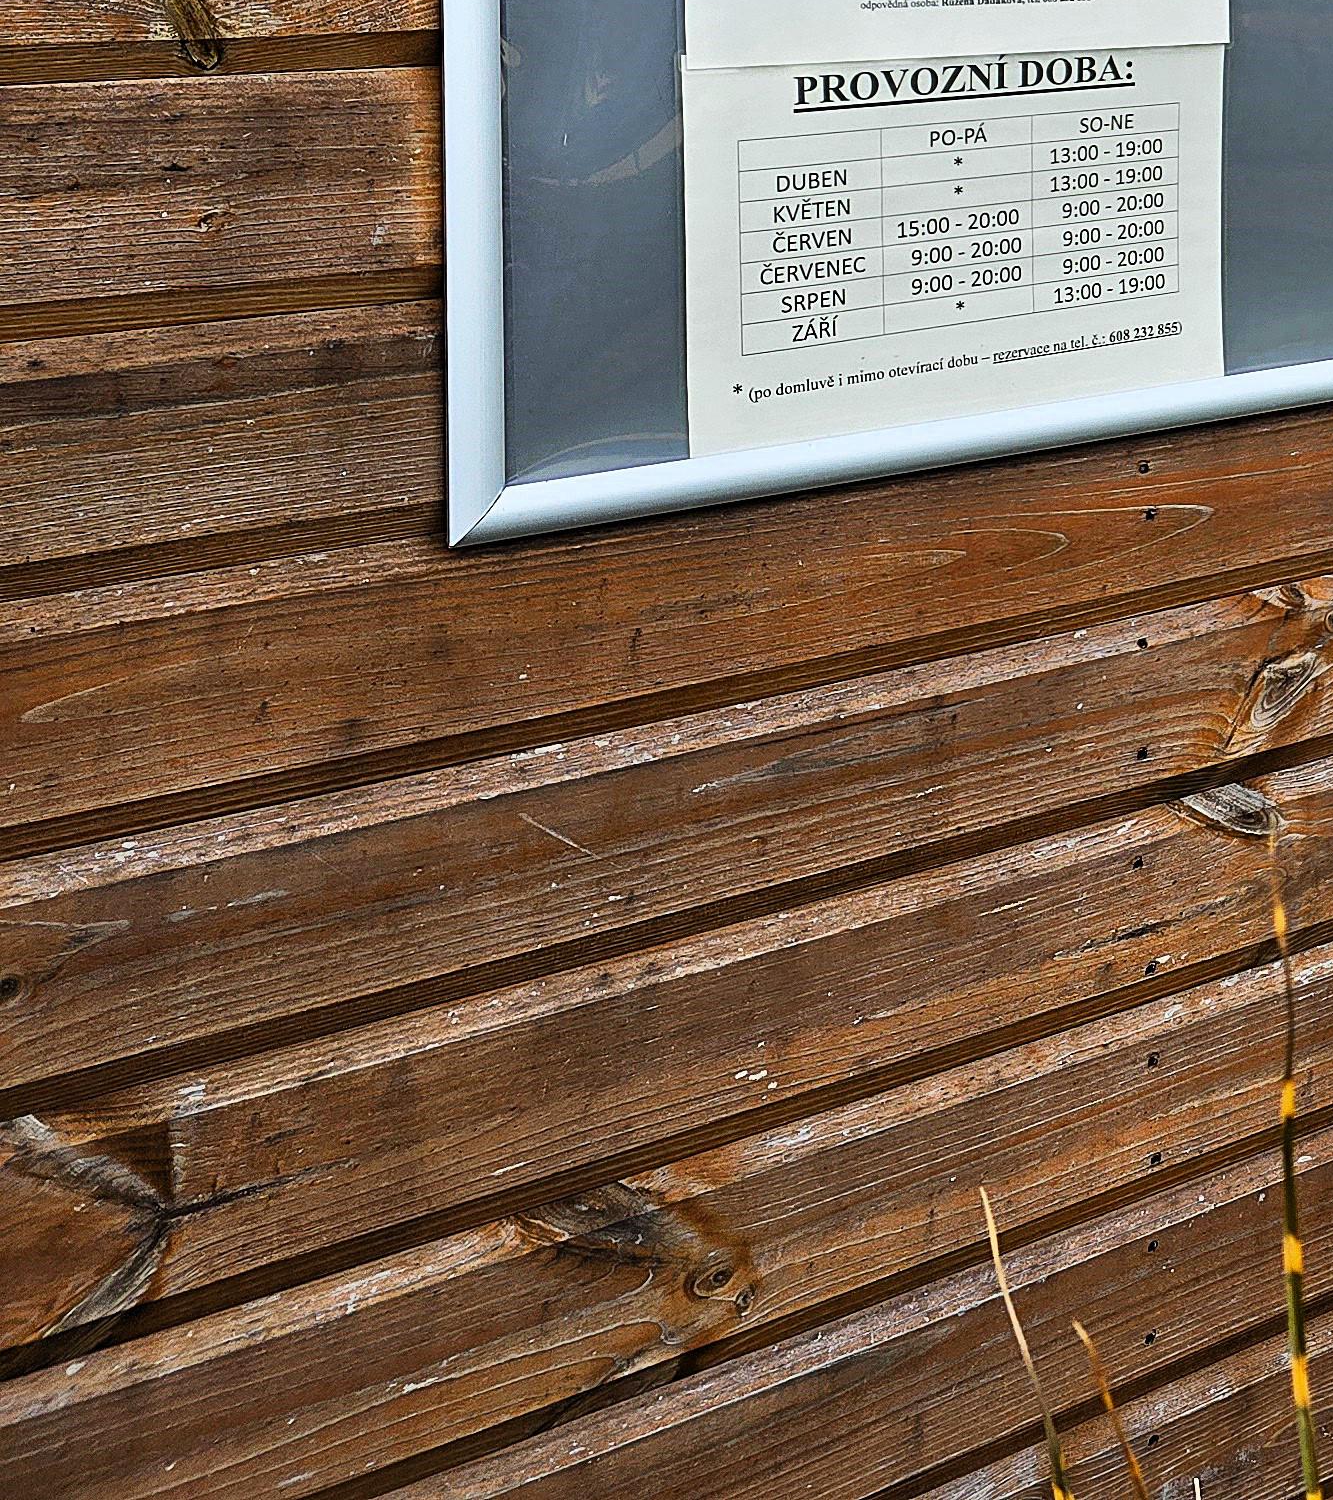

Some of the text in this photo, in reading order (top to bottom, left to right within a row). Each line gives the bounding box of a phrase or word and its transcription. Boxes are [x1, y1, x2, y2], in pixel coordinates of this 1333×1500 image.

[860, 0, 908, 11] odpovědná
[794, 54, 1135, 106] PROVOZNÍ DOBA:
[929, 113, 1135, 148] PO-PÁ SO-NE
[773, 165, 1163, 224] KVĚTEN 13:00 19:00
[776, 137, 1163, 193] DUBEN 13:00 19:00
[760, 219, 1164, 286] ČERVENEC 9:00 20:00 9:00 20:00
[772, 191, 1164, 254] ČERVEN 15:00 20:00 9:00 20:00
[781, 247, 1164, 314] SRPEN 9:00 20:00 9:00 20:00
[792, 274, 1166, 343] ZÁŘÍ 13:00 19:00
[748, 321, 1183, 403] (po domluvě i mimo otevírací dobu rezervace na tel. č.: 608 232 855)
